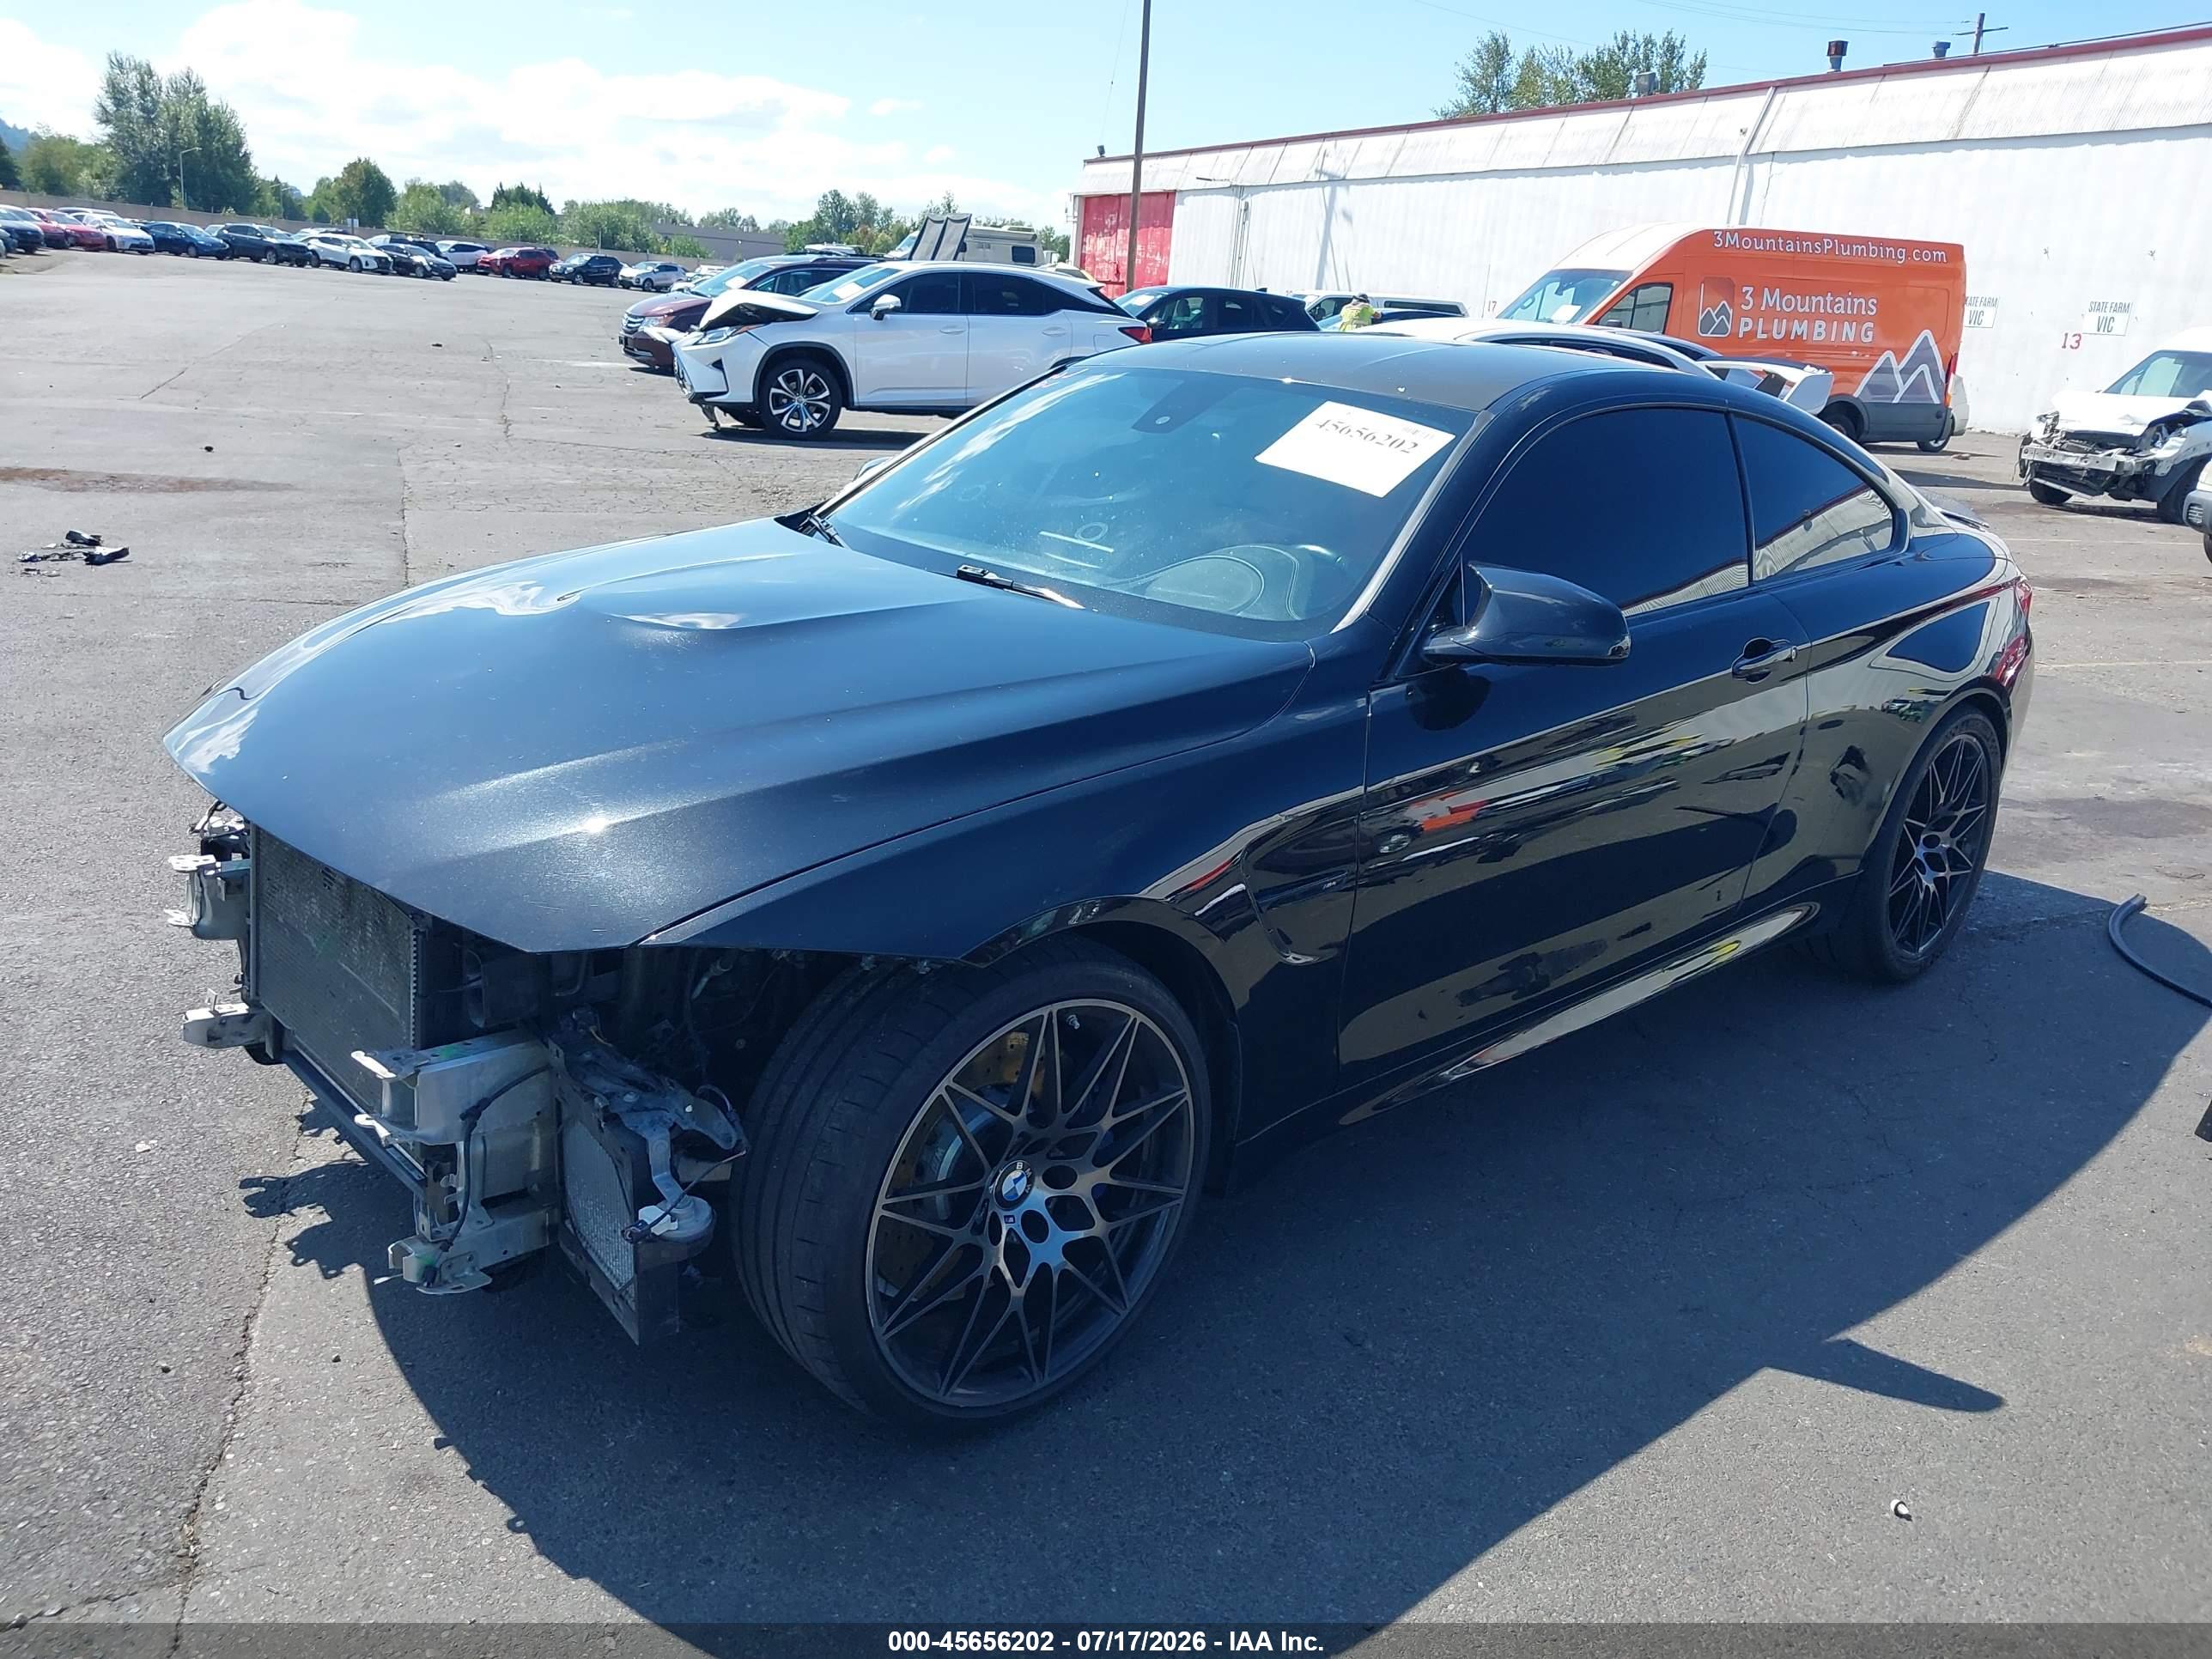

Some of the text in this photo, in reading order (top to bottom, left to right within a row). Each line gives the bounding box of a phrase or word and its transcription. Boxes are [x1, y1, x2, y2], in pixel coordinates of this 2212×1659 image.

[1713, 231, 1948, 263] 3MountainsPlumbing.com
[1741, 286, 1877, 315] 3 Mountains
[2088, 301, 2130, 313] STATE FARM
[1968, 310, 1984, 325] VIC
[2097, 315, 2115, 332] VIC
[1738, 317, 1875, 342] PLUMBING
[2062, 332, 2081, 349] 13
[1315, 419, 1419, 453] 45656202
